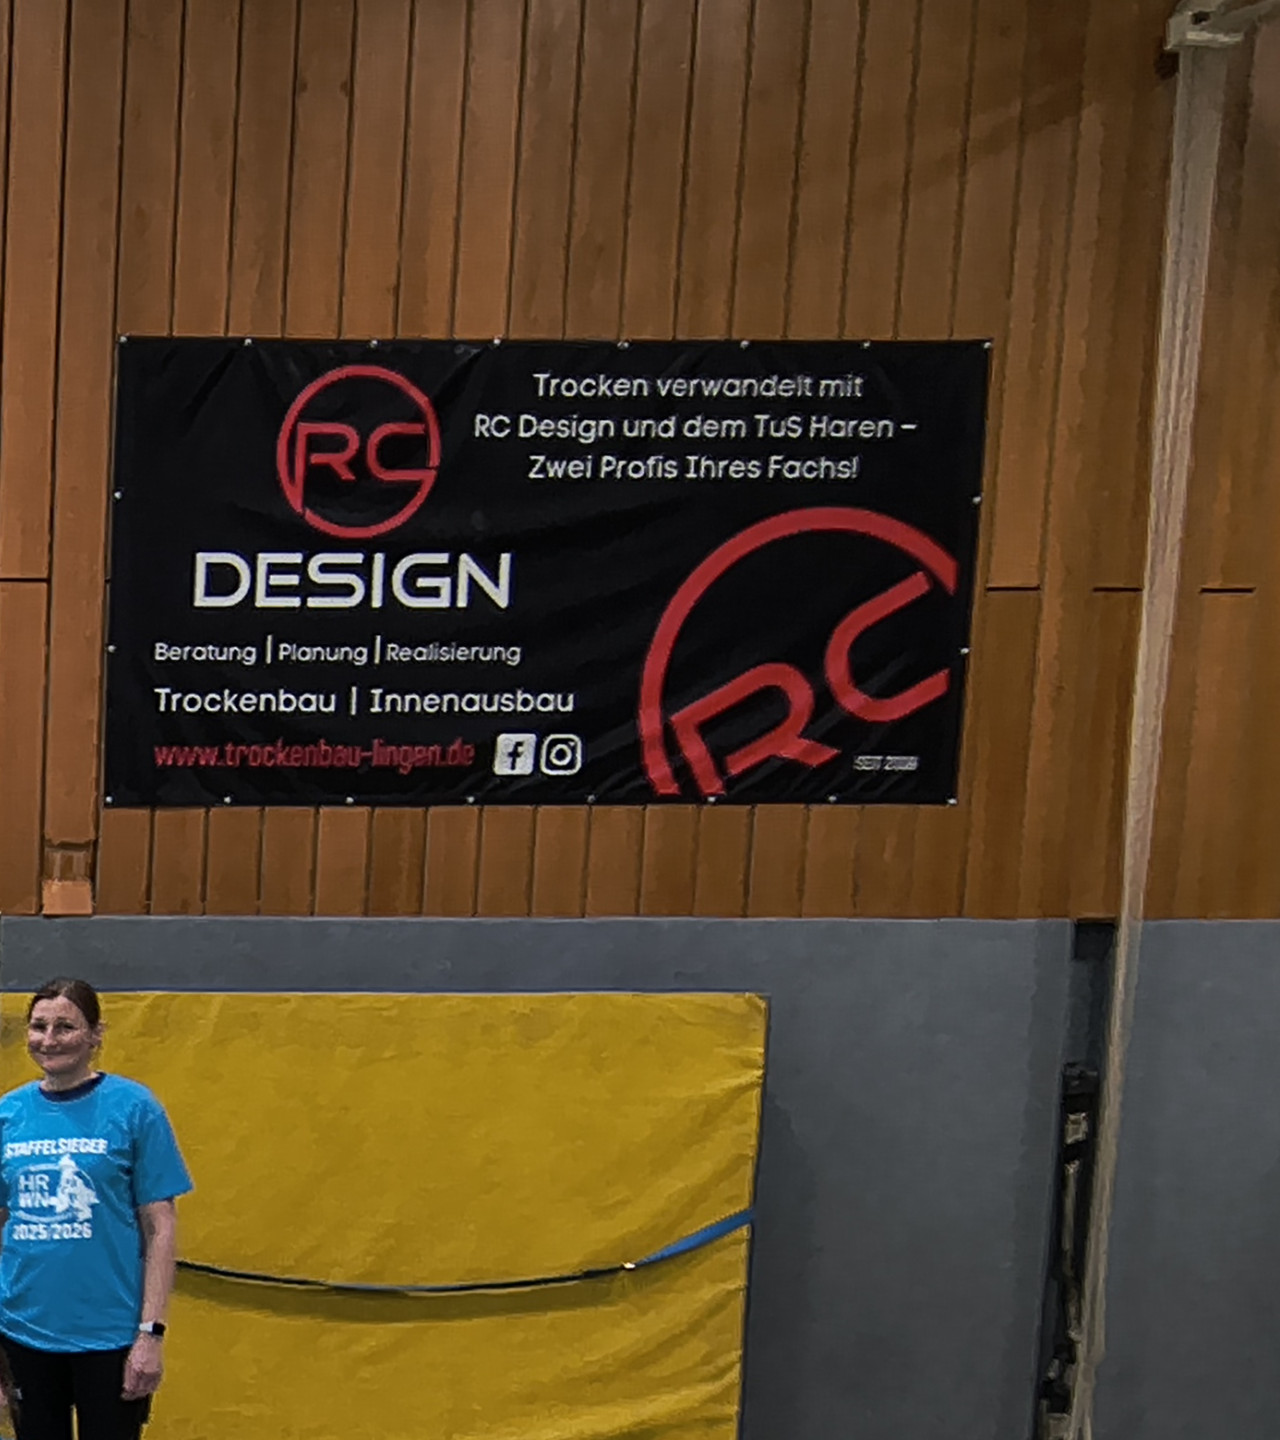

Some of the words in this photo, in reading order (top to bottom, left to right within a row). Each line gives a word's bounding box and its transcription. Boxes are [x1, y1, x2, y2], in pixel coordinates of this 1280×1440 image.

[533, 373, 648, 398] Trocken
[656, 373, 813, 398] verwandelt
[819, 373, 864, 398] mit
[474, 414, 511, 438] RC
[518, 413, 615, 444] Design
[623, 414, 676, 438] und
[683, 414, 745, 438] dem
[754, 413, 803, 438] TuS
[808, 414, 894, 438] Haren
[528, 455, 592, 480] Zwei
[600, 455, 679, 480] Profis
[685, 455, 762, 480] Ihres
[767, 455, 859, 480] Fachs!
[192, 552, 513, 608] DESIGN
[154, 642, 257, 665] Beratung
[278, 643, 368, 665] Planung
[386, 643, 521, 665] Realisierung
[154, 688, 336, 713] Trockenbau
[369, 688, 575, 713] Innenausbau
[153, 738, 475, 774] www.trockenbau-lingen.de
[3, 1137, 108, 1159] STAFFELSIEGER
[19, 1173, 49, 1191] HR
[19, 1191, 50, 1208] WN
[12, 1223, 93, 1241] 2025/2026
